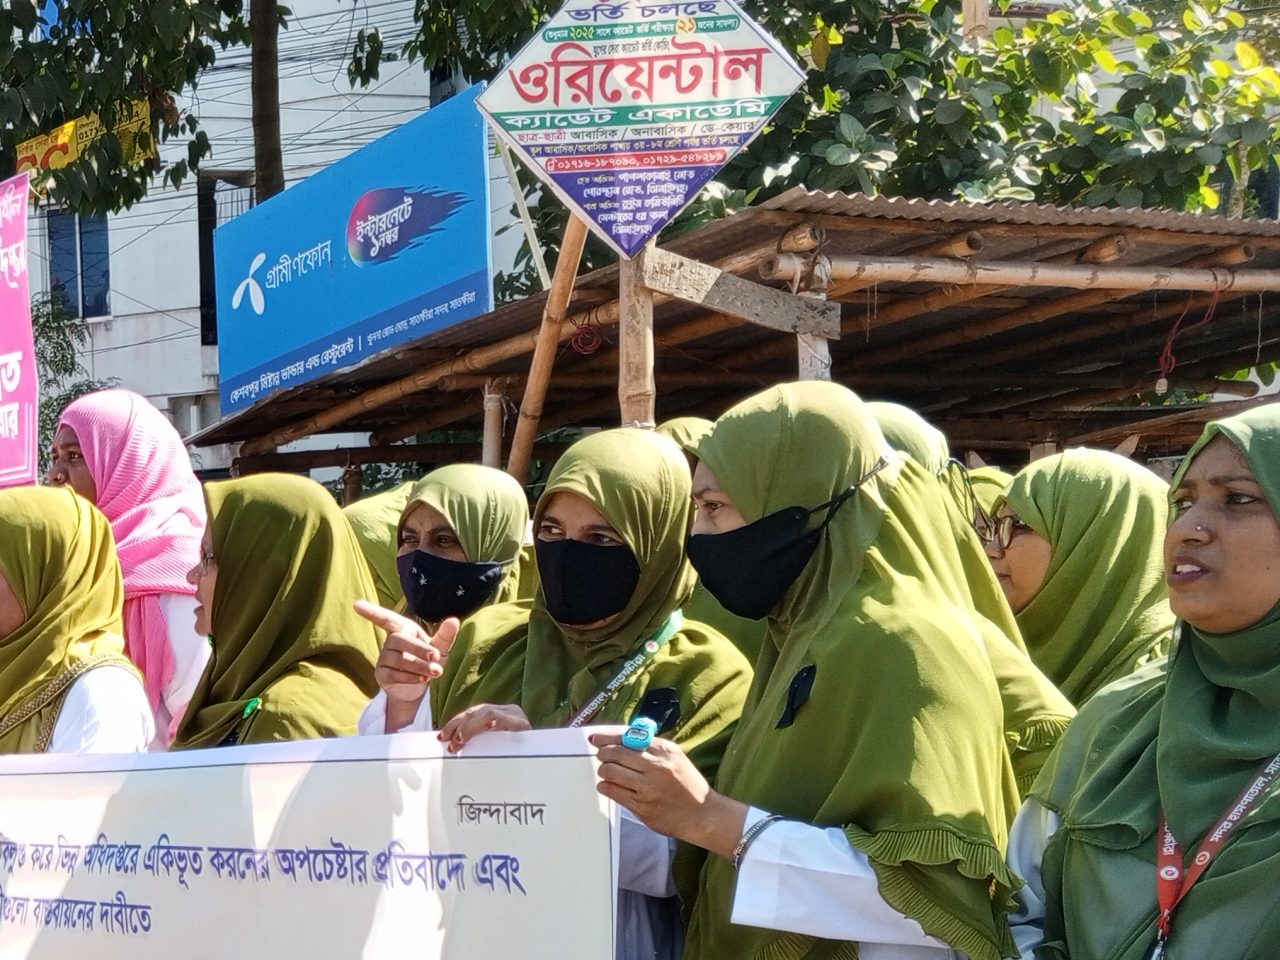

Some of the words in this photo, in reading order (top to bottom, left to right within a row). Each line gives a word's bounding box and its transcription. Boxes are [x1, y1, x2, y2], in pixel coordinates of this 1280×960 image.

[565, 3, 631, 22] ভর্তি
[636, 0, 721, 18] চলছে
[569, 27, 595, 40] ২০২৫
[677, 18, 696, 31] ২১
[509, 36, 772, 106] ওরিয়েন্টাল
[500, 108, 617, 129] ক্যাডেট
[628, 97, 771, 122] একাডেমি
[570, 127, 619, 141] আবাসিক
[631, 124, 687, 137] অনাবাসিক
[355, 196, 414, 243] ইন্টারনেটে
[265, 239, 332, 290] গ্রামীণফোন
[457, 794, 546, 826] জিন্দাবাদ
[30, 844, 53, 872] করে
[83, 833, 141, 877] অধিদপ্তরে
[143, 833, 203, 890] একিভূত
[207, 845, 270, 885] করনের
[273, 838, 368, 887] অপচেষ্টার
[475, 853, 526, 896] এবং
[98, 891, 151, 936] দাবীতে
